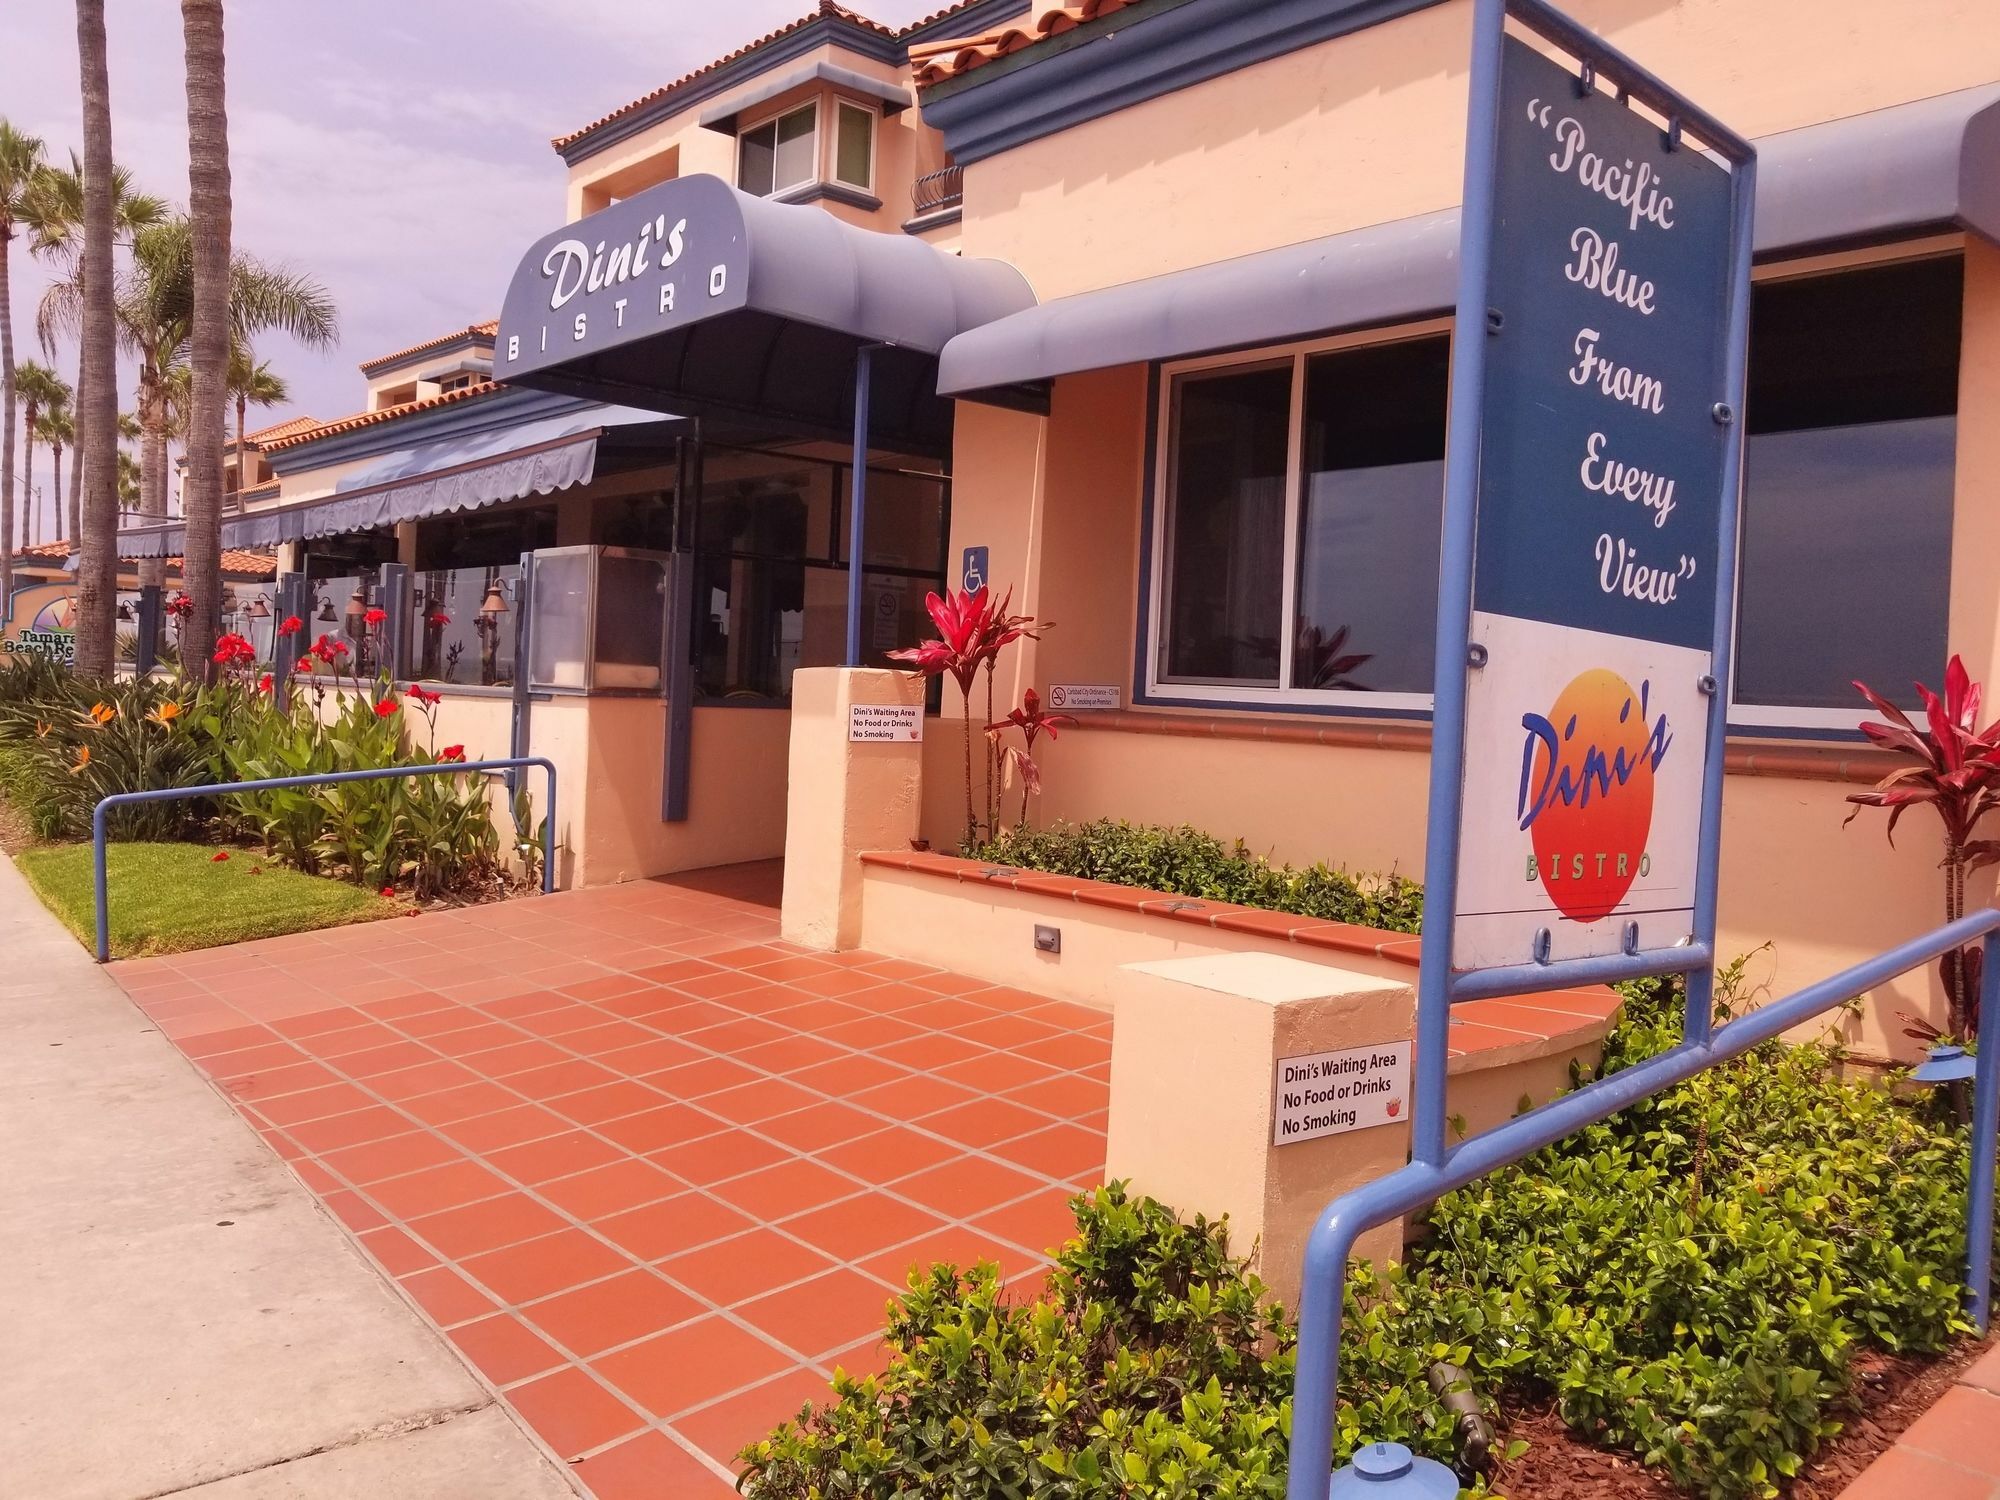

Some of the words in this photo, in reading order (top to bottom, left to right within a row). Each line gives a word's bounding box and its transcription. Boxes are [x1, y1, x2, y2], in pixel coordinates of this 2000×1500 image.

[542, 214, 687, 310] Dini's
[1565, 227, 1655, 315] Blue
[507, 264, 727, 362] BISTRO
[1569, 327, 1664, 414] From
[1580, 432, 1676, 528] Every
[874, 709, 899, 717] Waiting
[1077, 698, 1092, 706] Smoking
[864, 731, 894, 739] Smoking
[1517, 679, 1673, 832] Dini's
[1526, 853, 1651, 881] BISTRO
[1285, 1063, 1319, 1083] Dini's
[1322, 1057, 1367, 1077] Waiting
[1370, 1054, 1397, 1069] Area
[1283, 1093, 1301, 1109] No
[1304, 1085, 1335, 1105] Food
[1337, 1086, 1350, 1099] or
[1353, 1077, 1391, 1096] Drinks
[1282, 1119, 1300, 1135] No
[1303, 1109, 1356, 1131] Smoking
